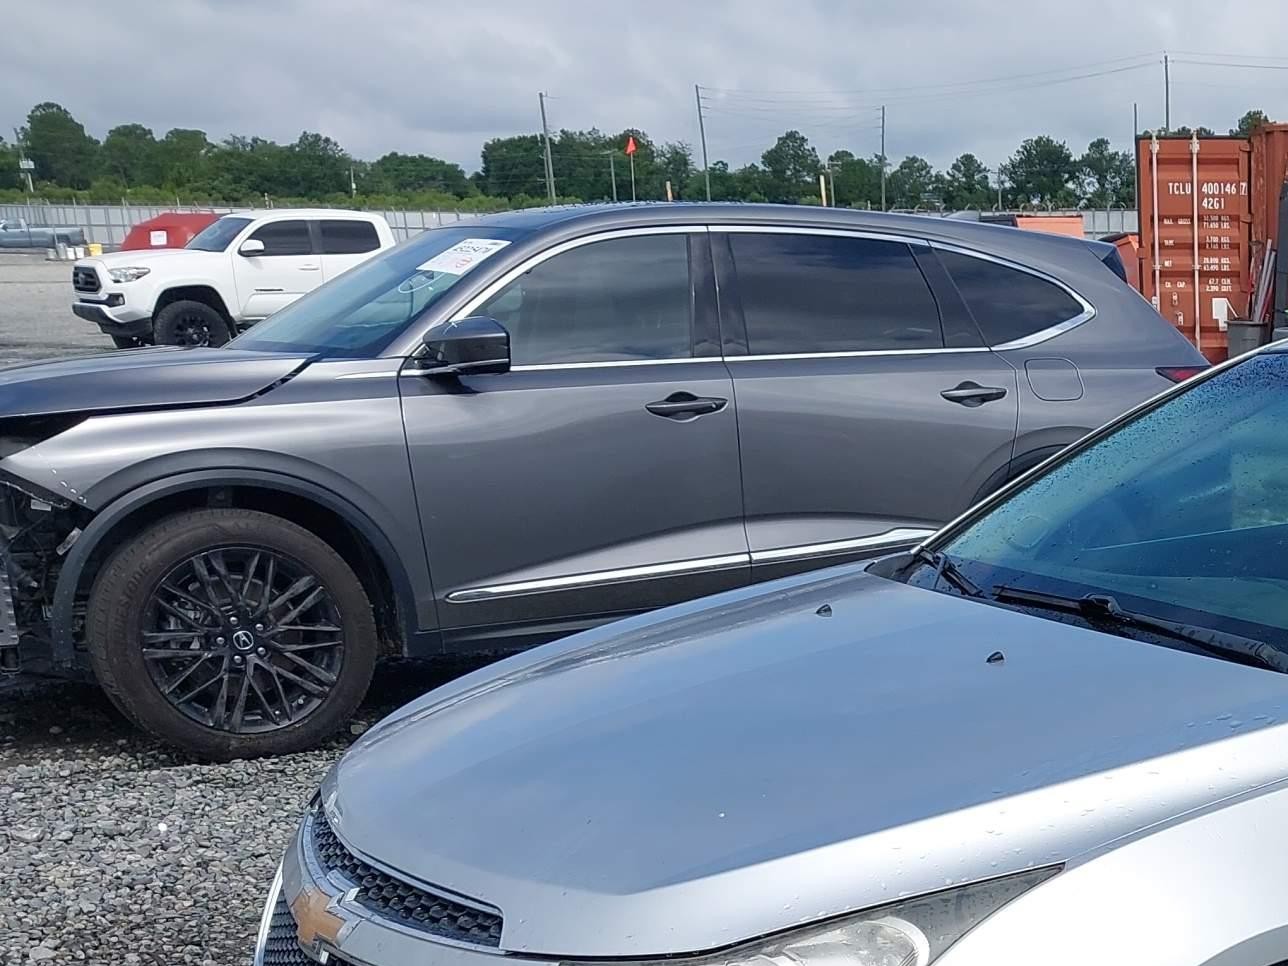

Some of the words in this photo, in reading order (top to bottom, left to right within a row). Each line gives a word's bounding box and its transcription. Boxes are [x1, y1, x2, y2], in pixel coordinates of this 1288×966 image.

[1168, 182, 1192, 194] TCLU
[1201, 182, 1237, 194] 400146
[1201, 198, 1225, 209] 42G1
